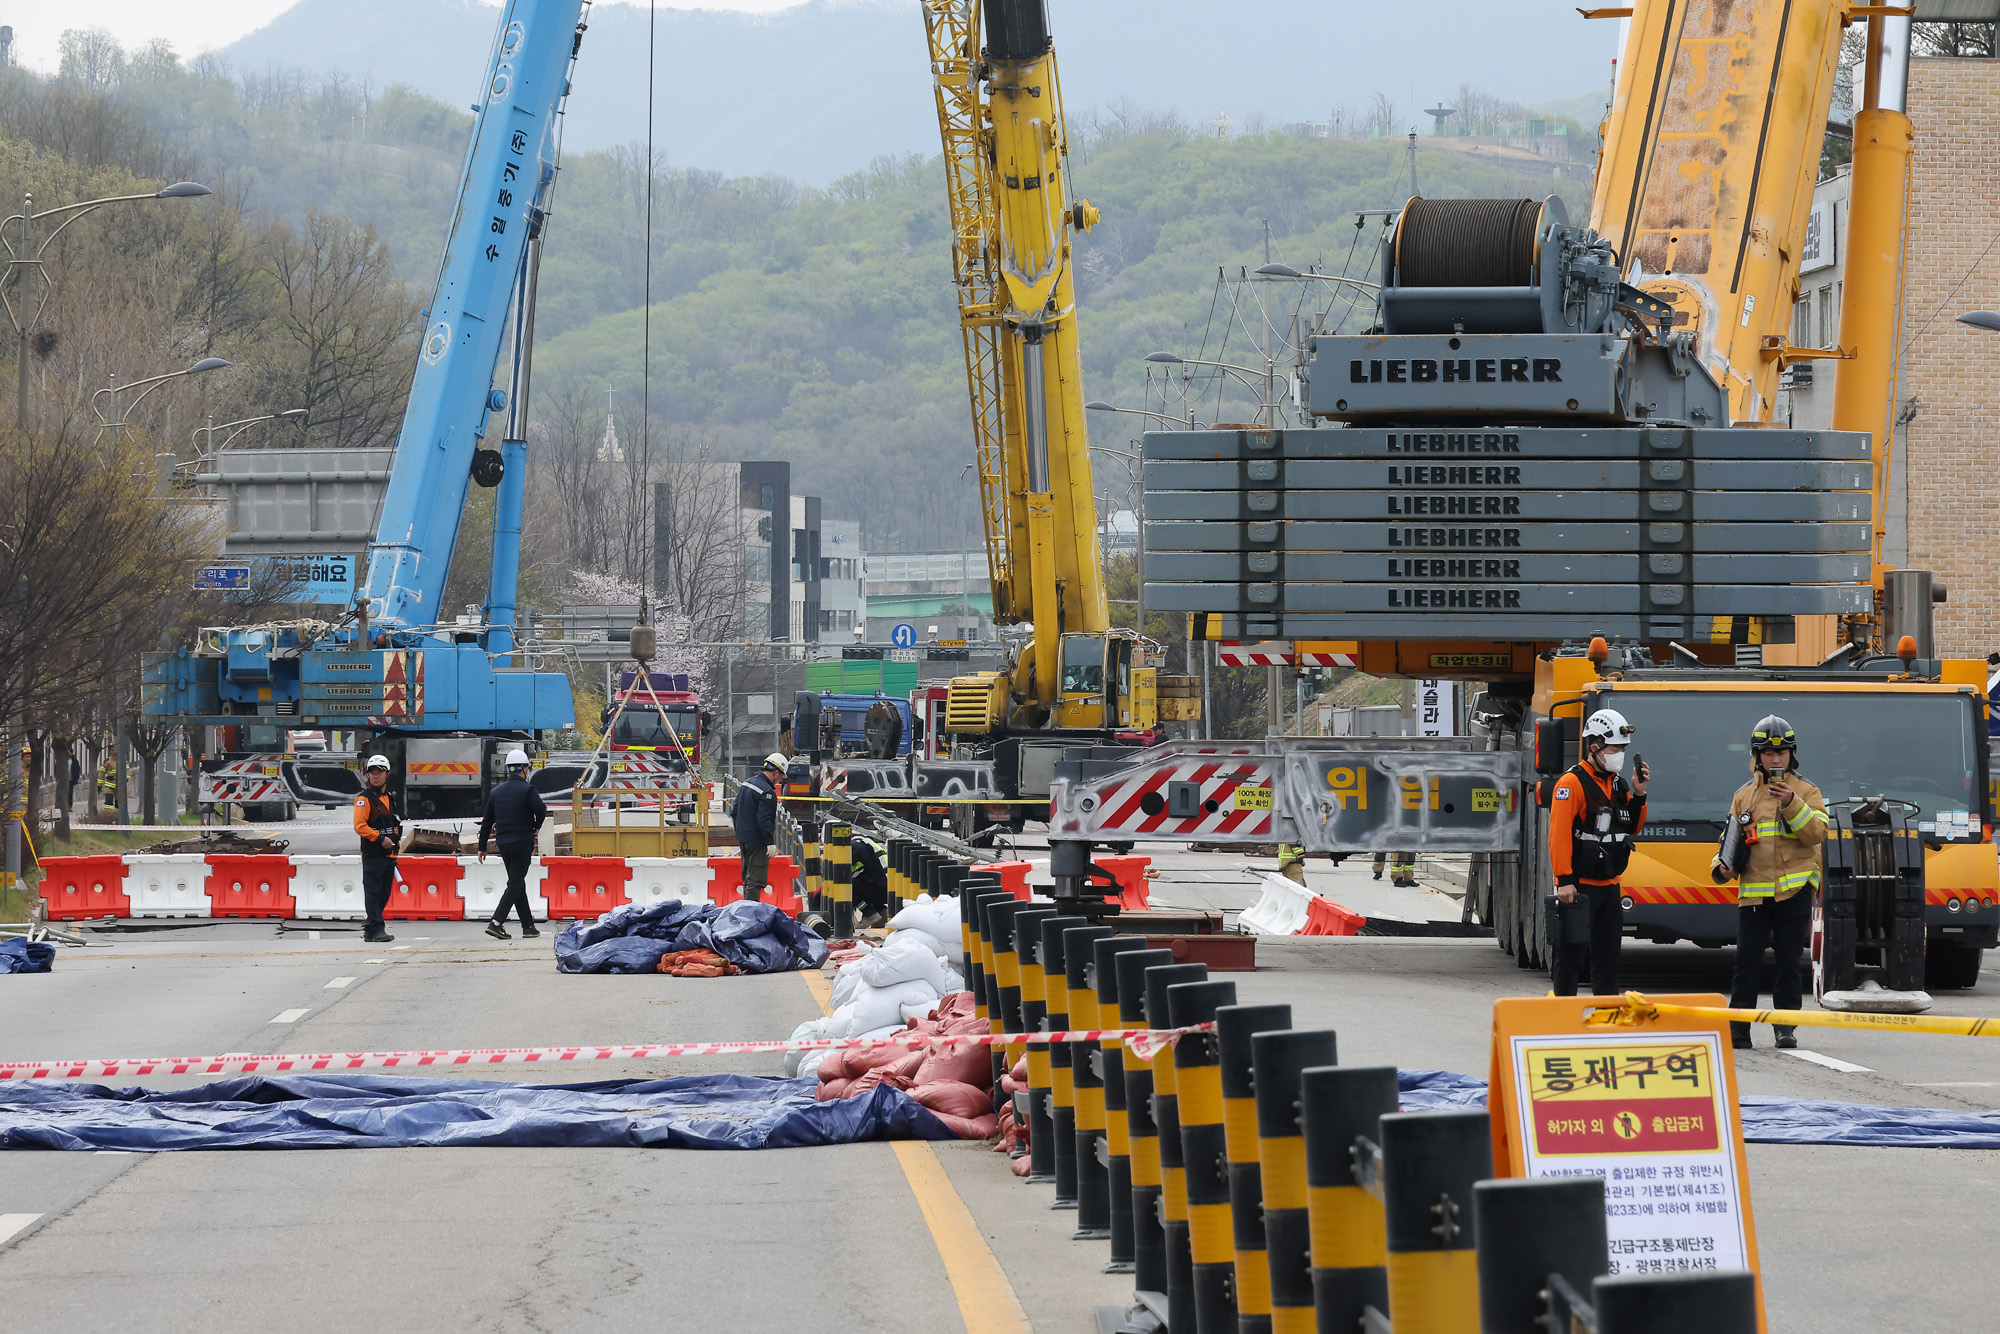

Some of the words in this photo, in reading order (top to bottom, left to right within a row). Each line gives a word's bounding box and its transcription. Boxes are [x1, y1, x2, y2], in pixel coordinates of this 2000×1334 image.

[1350, 358, 1563, 383] LIEBHERR
[1386, 433, 1521, 452] LIEBHERR
[1388, 465, 1521, 485] LIEBHERR
[1388, 495, 1521, 515] LIEBHERR
[1388, 527, 1521, 547] LIEBHERR
[1388, 558, 1521, 578] LIEBHERR
[1388, 588, 1521, 608] LIEBHERR
[1436, 656, 1509, 667] 작업반경내
[679, 732, 694, 740] 구조
[1239, 799, 1253, 807] 필수
[1256, 799, 1269, 807] 확인
[1258, 790, 1272, 798] 확장
[1637, 827, 1687, 836] HERR
[1541, 1053, 1700, 1093] 통제구역
[1547, 1119, 1587, 1135] 허가자
[1590, 1118, 1605, 1135] 외
[1651, 1115, 1705, 1133] 출입금지
[1611, 1166, 1657, 1180] 출입제한
[1661, 1166, 1685, 1179] 규정
[1689, 1164, 1724, 1178] 위반시
[1657, 1202, 1691, 1216] 의하여
[1694, 1200, 1728, 1215] 처벌함
